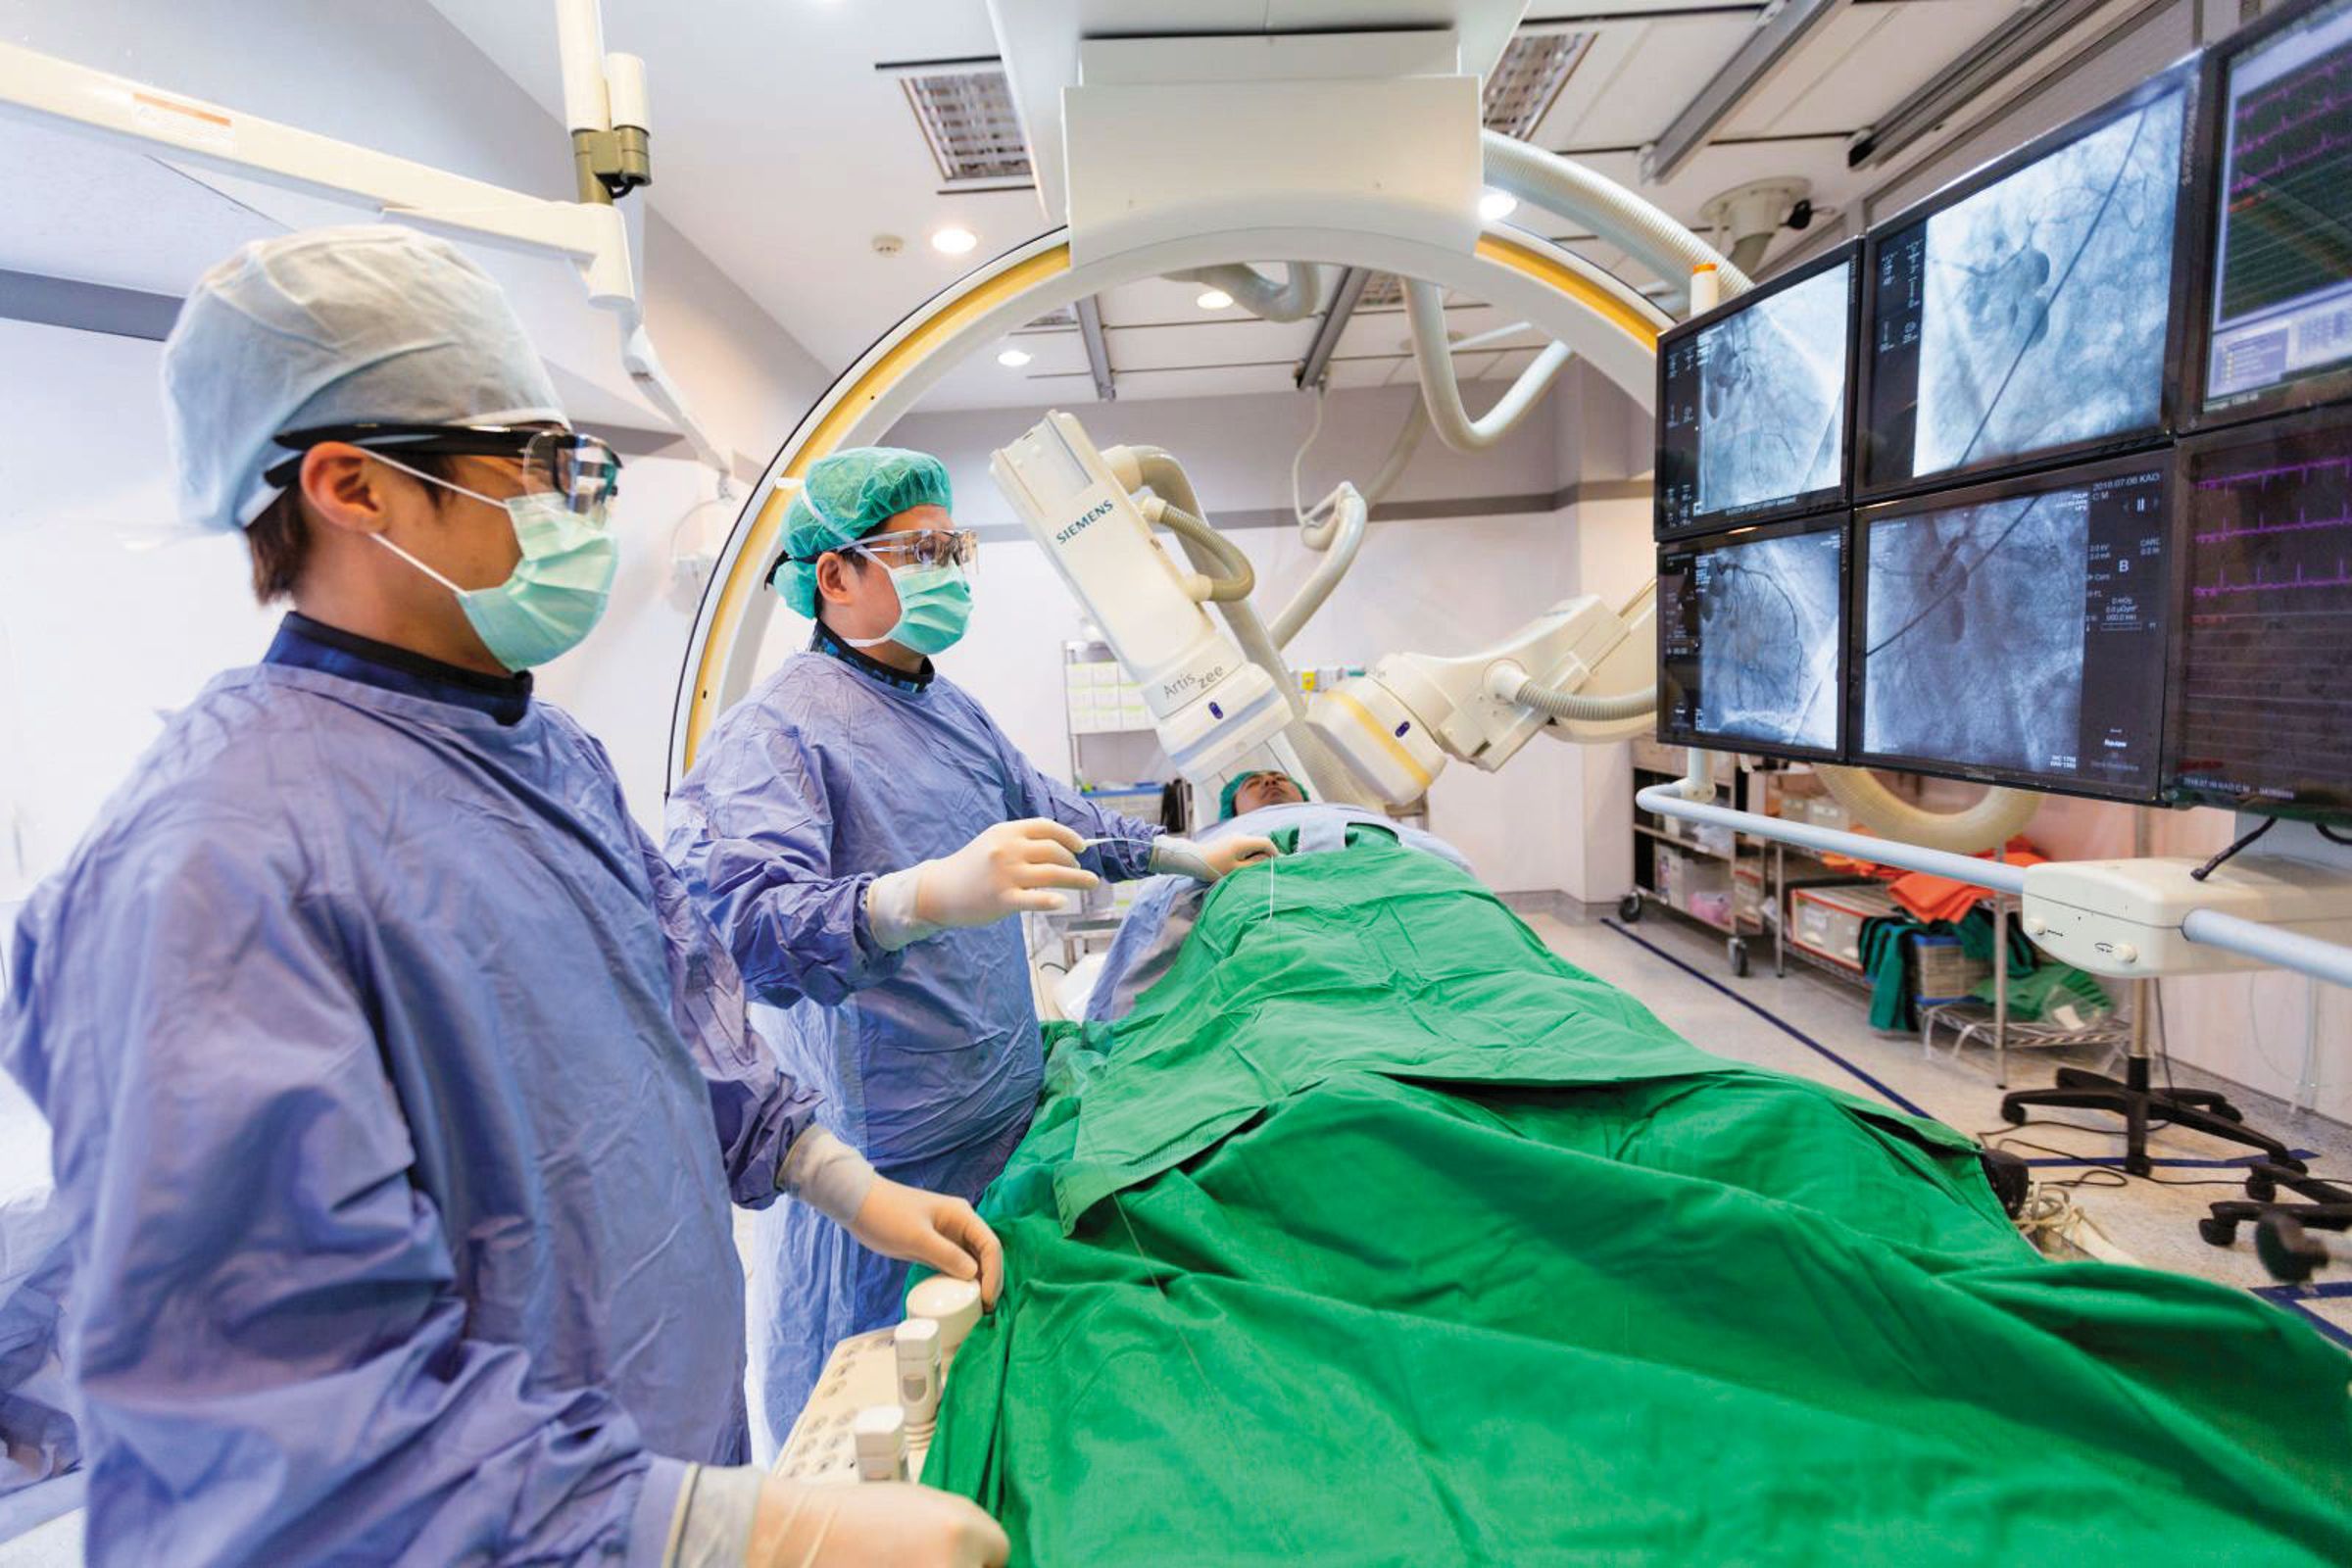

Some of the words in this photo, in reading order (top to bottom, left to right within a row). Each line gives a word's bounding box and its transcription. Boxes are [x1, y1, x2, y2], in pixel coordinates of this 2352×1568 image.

[1056, 499, 1113, 545] SIEMENS
[2119, 560, 2129, 572] B
[1163, 673, 1196, 700] Artis
[1198, 665, 1224, 690] zee
